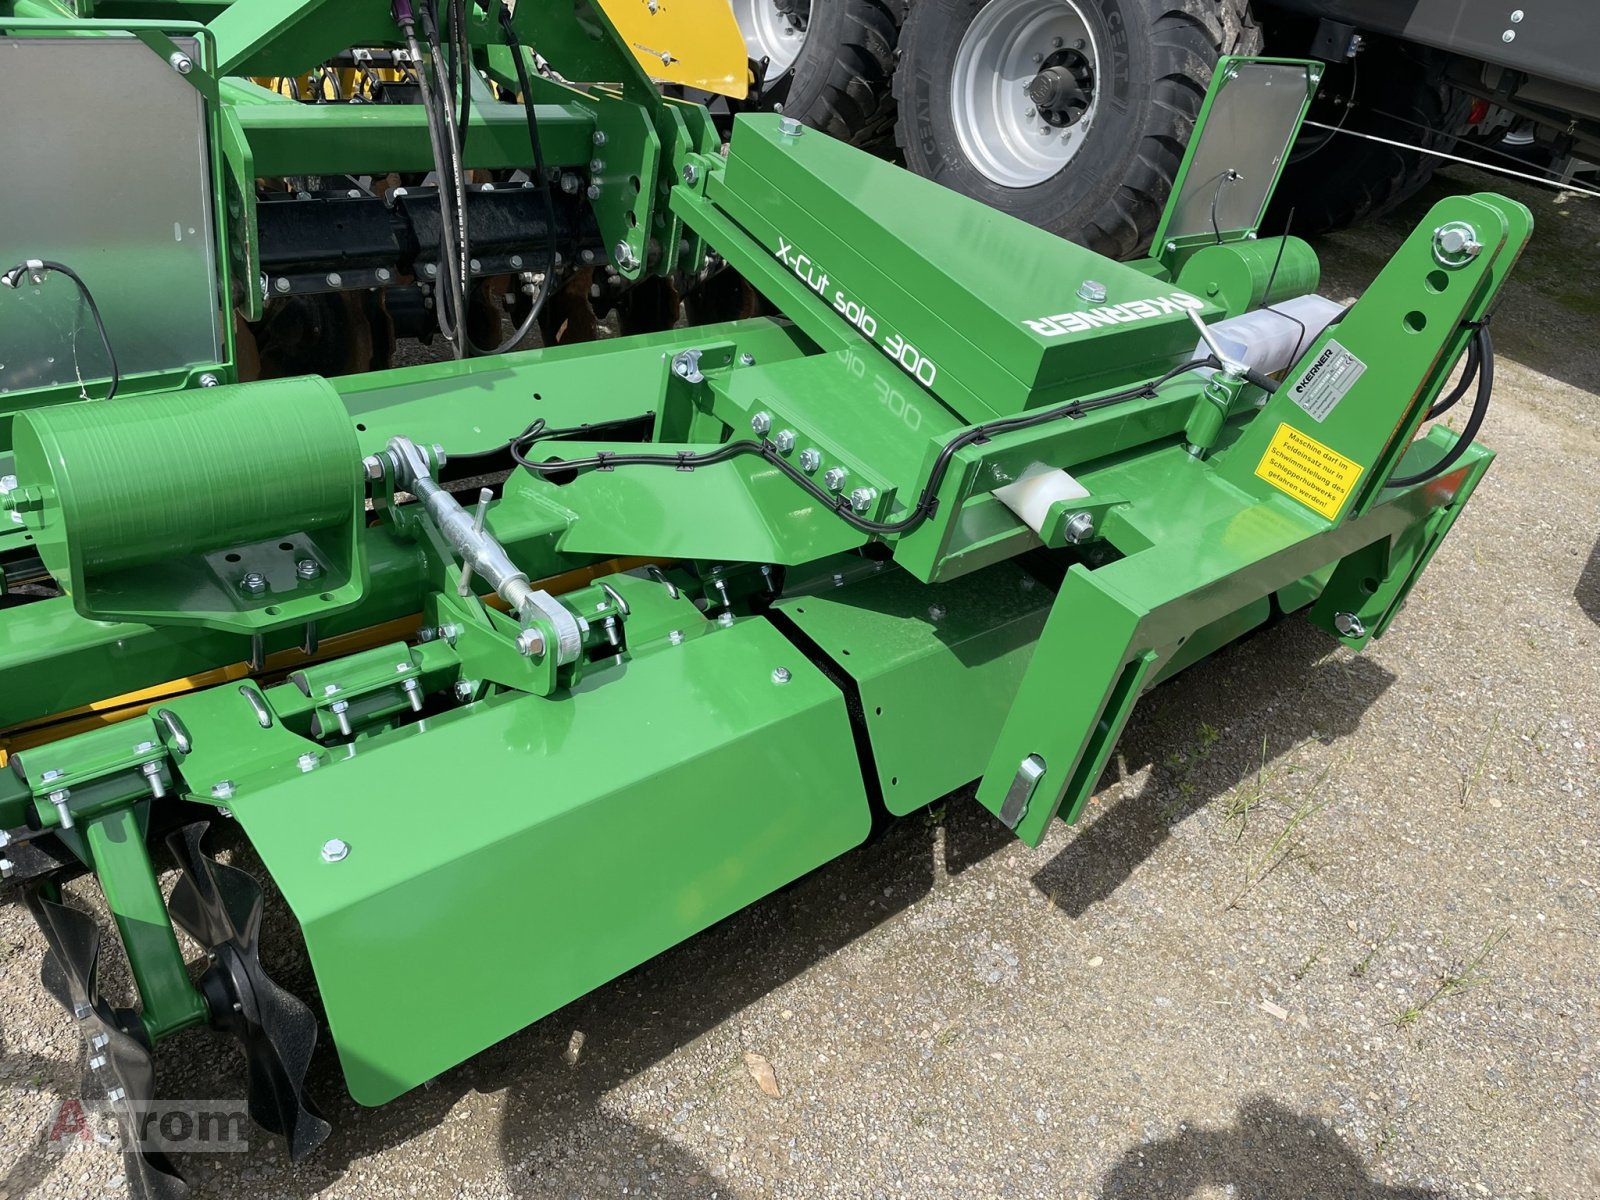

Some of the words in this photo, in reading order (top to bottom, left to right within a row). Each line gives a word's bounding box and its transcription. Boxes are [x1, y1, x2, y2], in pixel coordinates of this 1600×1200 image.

[1107, 10, 1129, 83] CEAT
[915, 95, 937, 155] CEAT
[775, 236, 830, 295] X-Cut
[833, 291, 877, 338] solo
[882, 334, 937, 387] 300
[1021, 296, 1189, 337] KERNER
[1299, 348, 1334, 389] KERNER
[1271, 447, 1331, 486] Schwimmstellung
[1331, 483, 1345, 494] des
[1282, 441, 1322, 468] Feldeinsatz
[1322, 465, 1335, 476] nur
[1335, 472, 1344, 481] in
[1288, 432, 1322, 455] Maschine
[1322, 452, 1339, 465] darf
[1338, 462, 1348, 471] im
[1268, 470, 1298, 491] gefahren
[1299, 486, 1328, 508] werden!
[1269, 458, 1336, 501] Schlepperhubwerks
